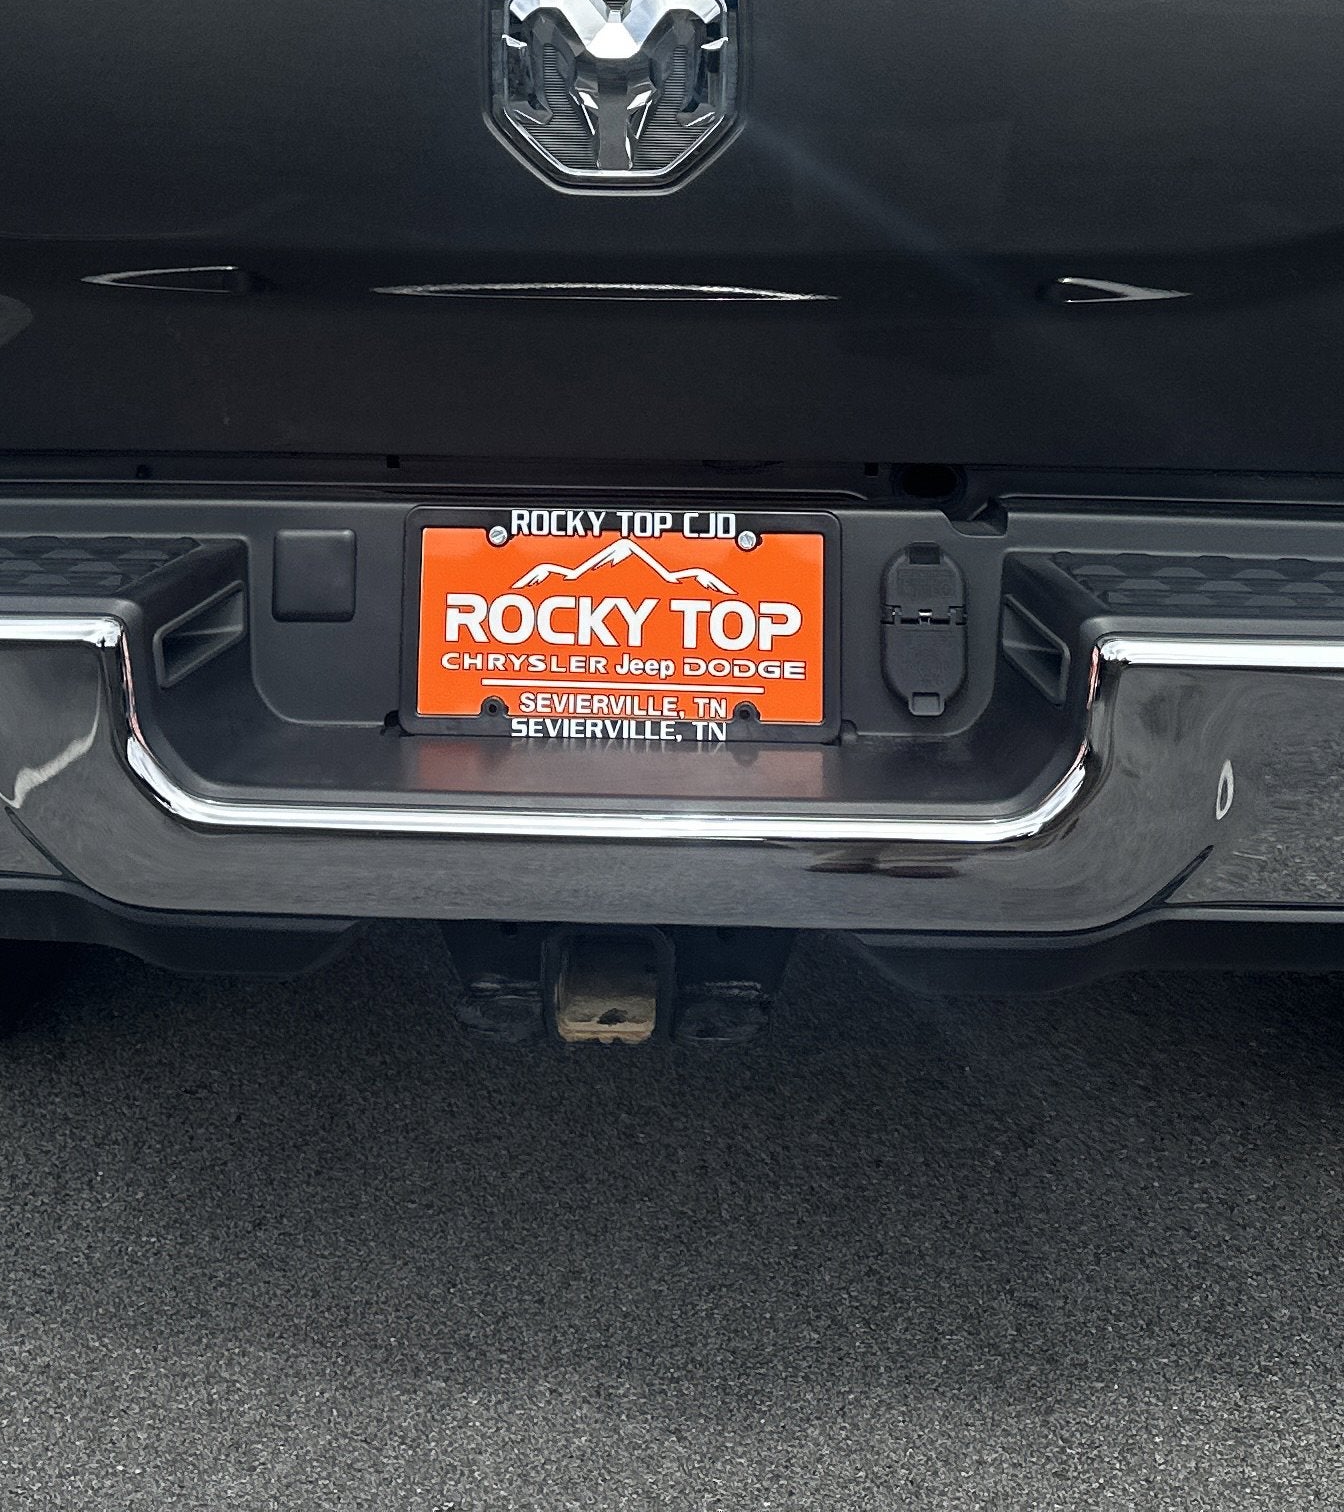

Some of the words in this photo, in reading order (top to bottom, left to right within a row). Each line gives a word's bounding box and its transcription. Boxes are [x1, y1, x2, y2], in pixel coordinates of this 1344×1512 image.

[510, 509, 606, 538] ROCKY
[616, 511, 673, 539] TOP
[682, 512, 737, 539] CJD
[444, 592, 660, 648] ROCKY
[670, 599, 802, 652] TOP
[440, 652, 608, 675] CHRYSLER
[614, 652, 676, 681] Jeep
[682, 657, 806, 680] DODGE
[518, 691, 686, 721] SEVIERVILLE,
[693, 697, 728, 719] TN
[510, 718, 683, 743] SEVIERVILLE,
[691, 722, 728, 742] TN
